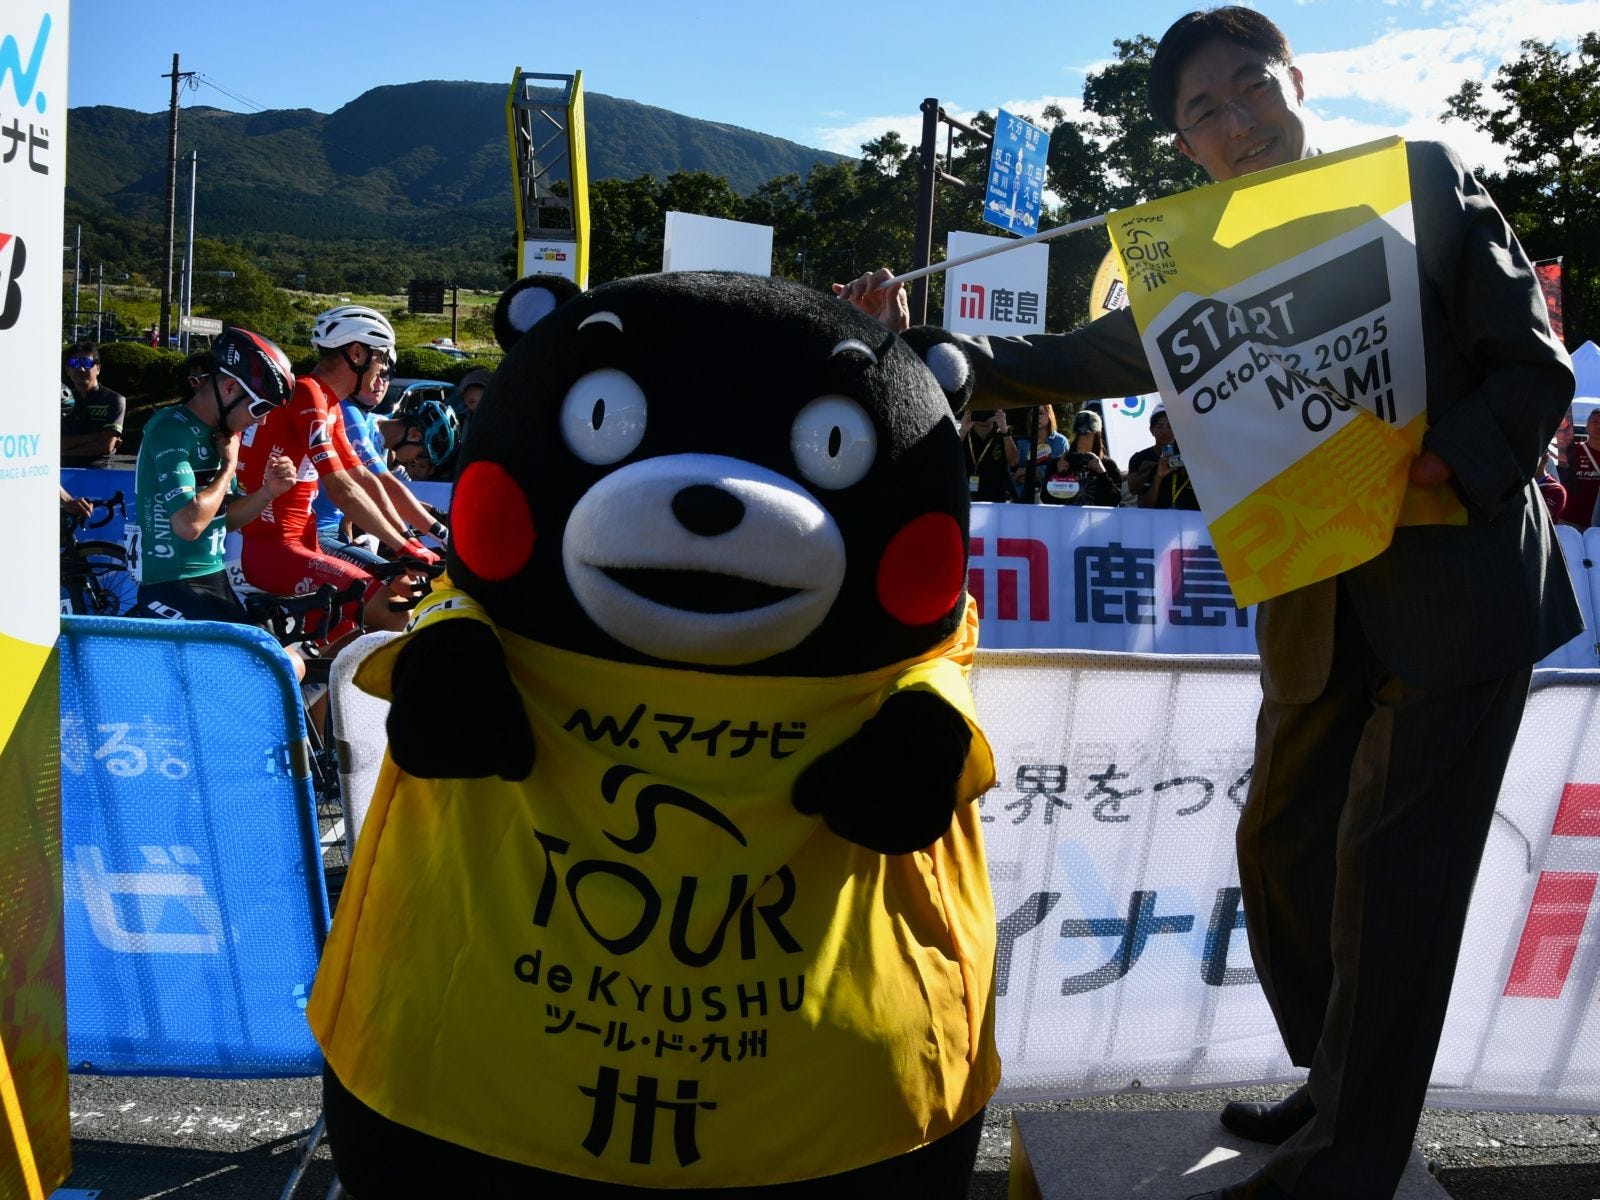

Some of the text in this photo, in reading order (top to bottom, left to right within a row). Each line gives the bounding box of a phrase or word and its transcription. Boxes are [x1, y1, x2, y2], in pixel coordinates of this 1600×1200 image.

[1120, 240, 1172, 266] TOUR
[989, 288, 1039, 325] 鹿島
[1171, 291, 1294, 374] START
[1315, 315, 1389, 372] 2025
[313, 452, 329, 462] UCI
[153, 492, 172, 541] NIPPO
[1073, 541, 1249, 628] 鹿島
[653, 713, 807, 759] マイナビ
[531, 827, 805, 968] TOUR
[513, 949, 806, 1024] de KYUSHU
[544, 1003, 768, 1064] ツール・ド・九州
